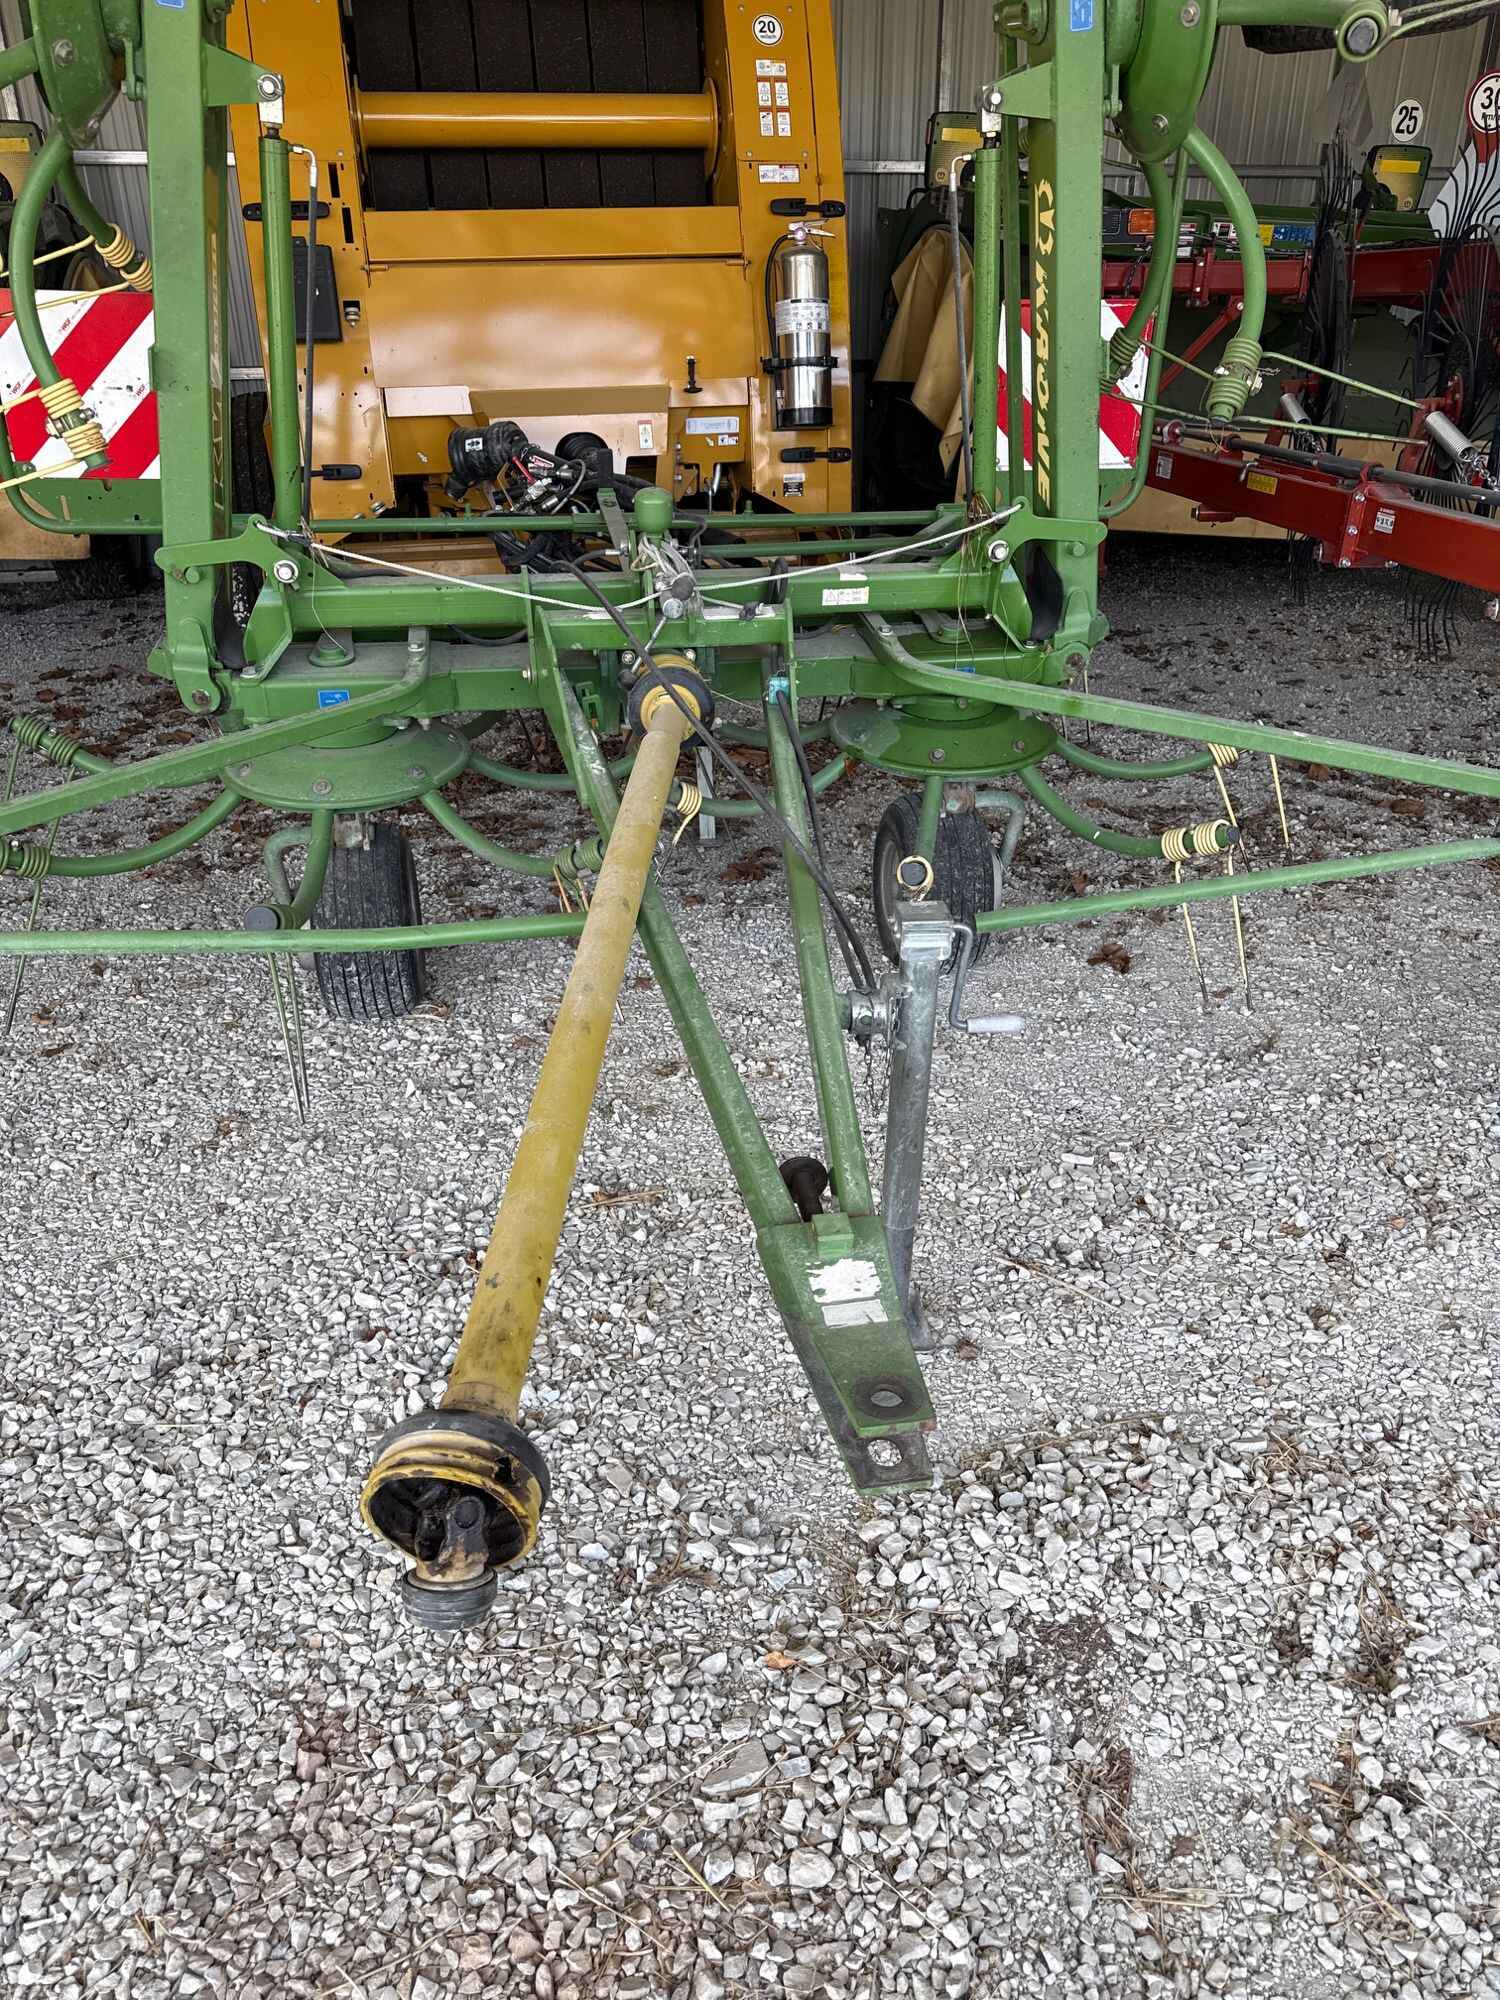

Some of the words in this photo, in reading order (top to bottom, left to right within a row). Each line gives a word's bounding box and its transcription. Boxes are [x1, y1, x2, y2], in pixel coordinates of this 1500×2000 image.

[758, 20, 776, 34] 20
[1395, 105, 1420, 135] 25
[1035, 260, 1052, 512] KRONE
